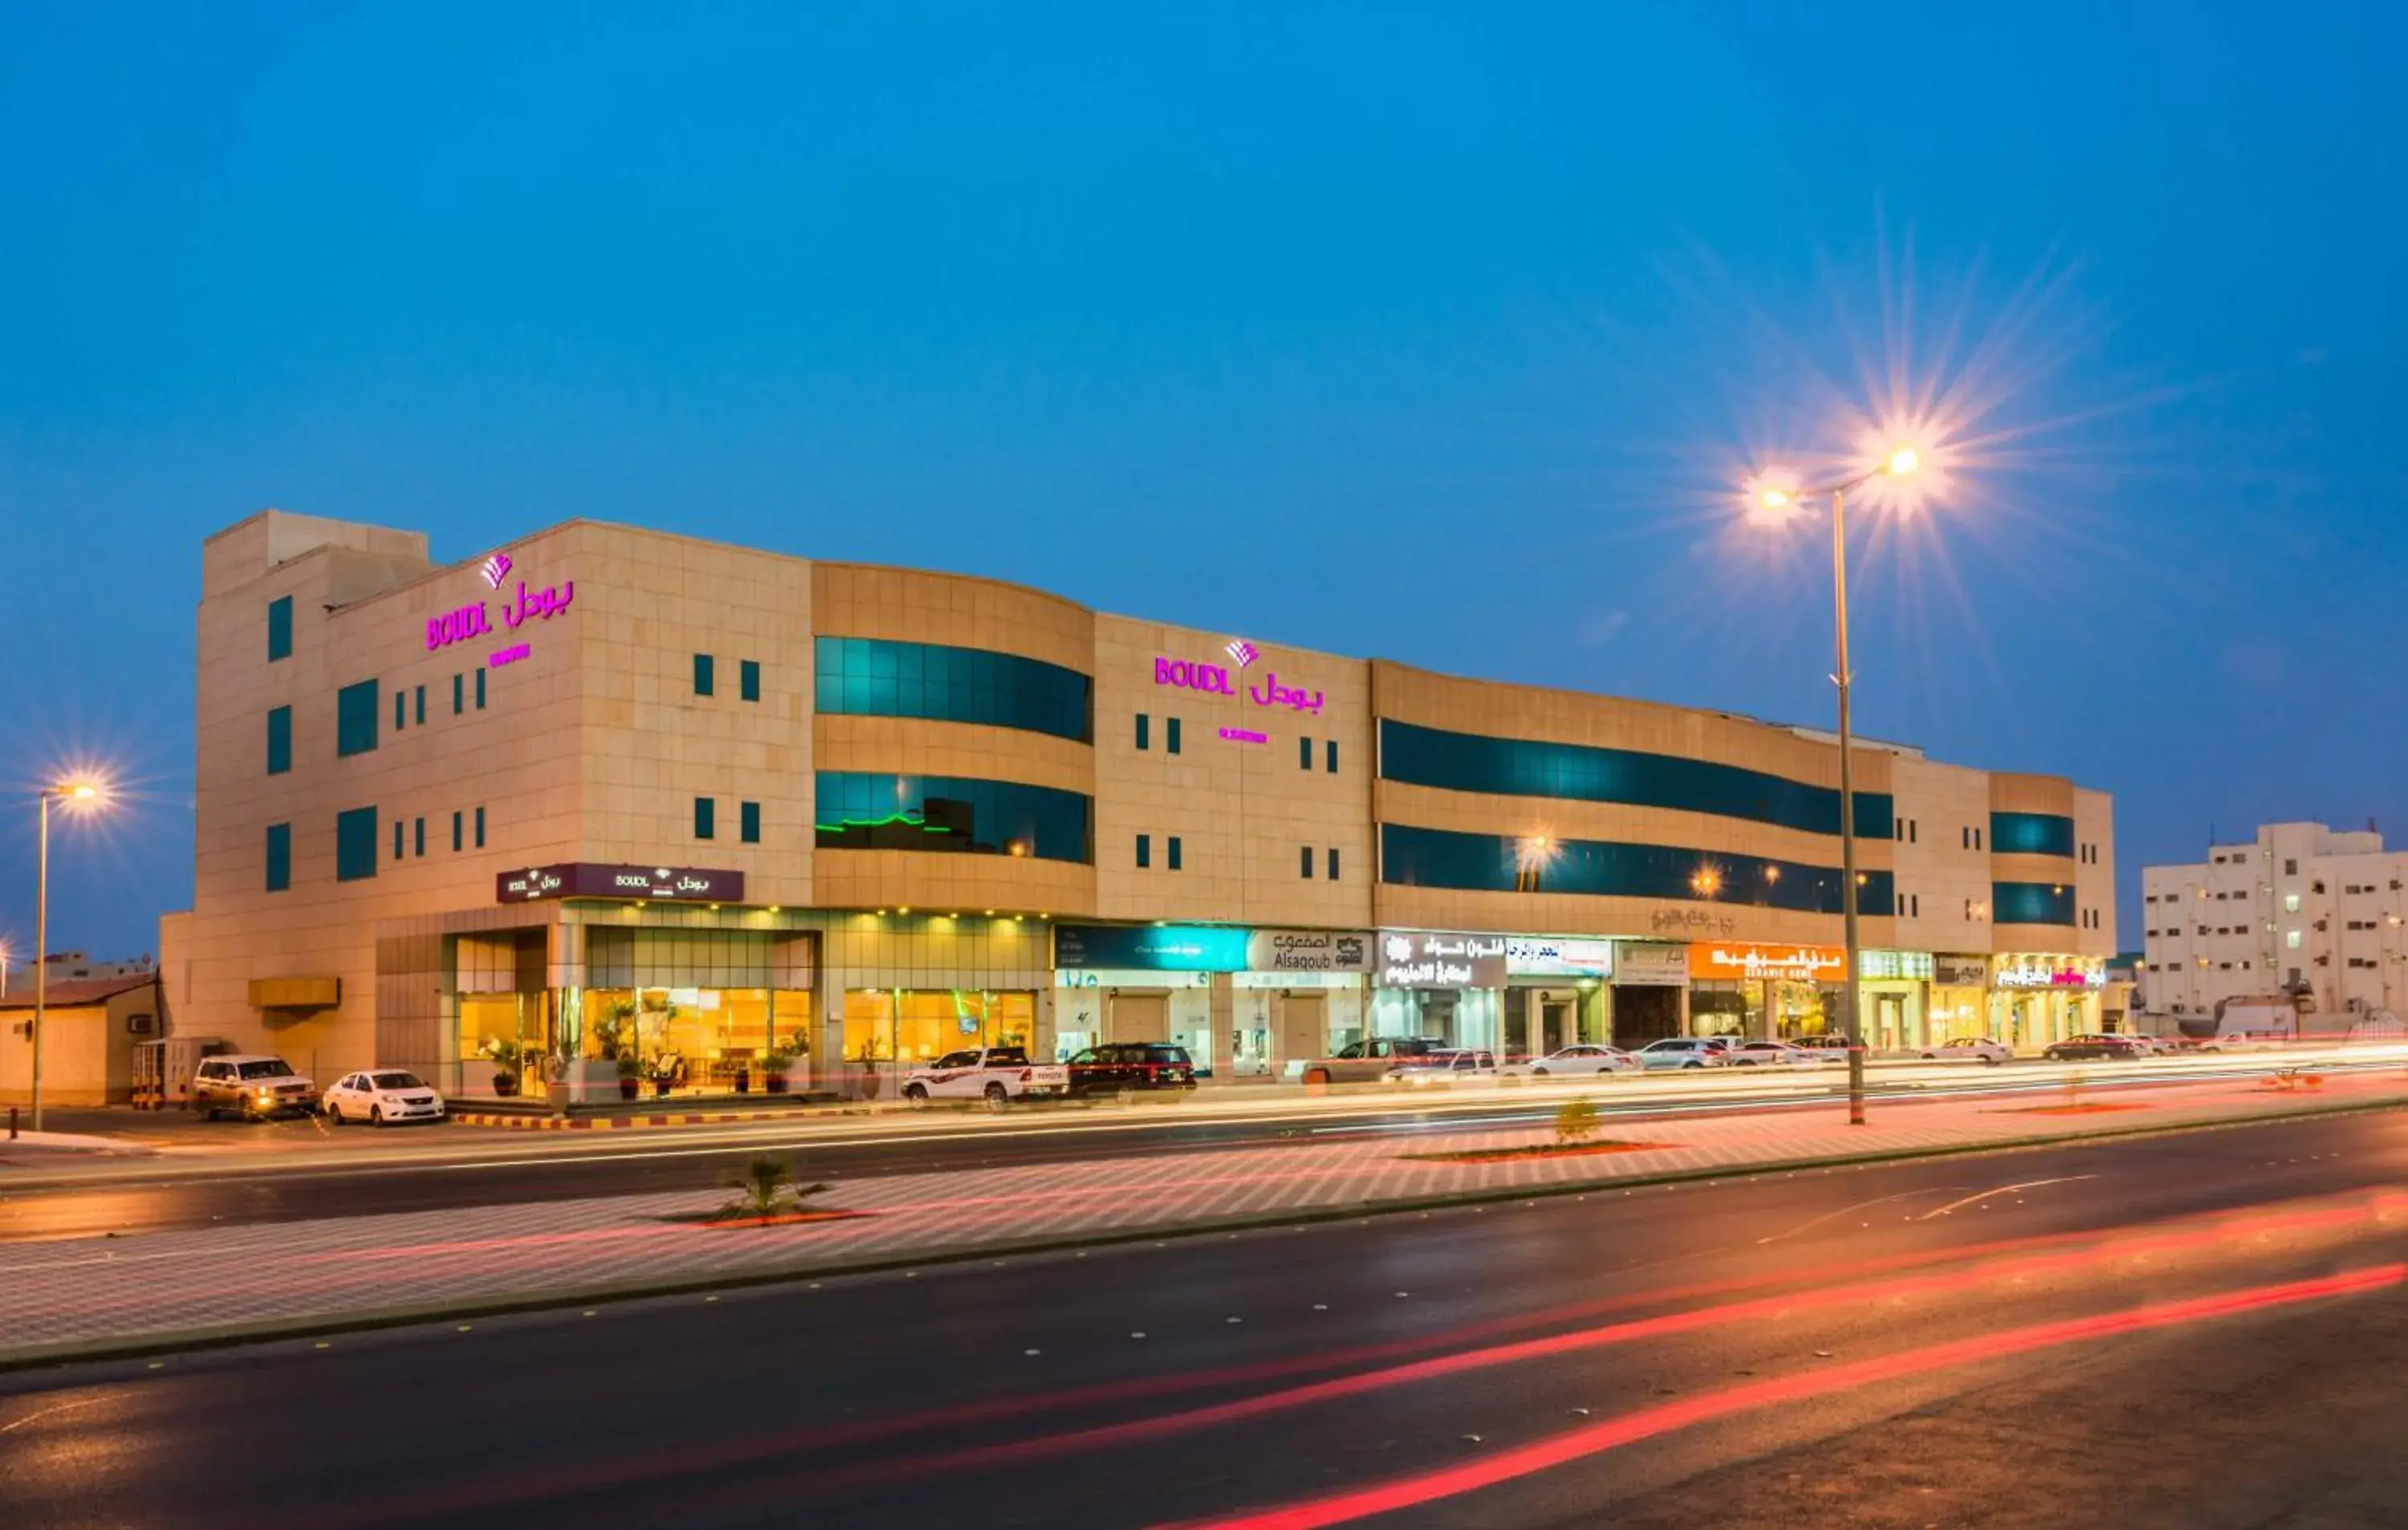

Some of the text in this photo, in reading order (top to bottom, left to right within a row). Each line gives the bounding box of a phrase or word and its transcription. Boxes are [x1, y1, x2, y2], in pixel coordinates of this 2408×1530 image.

[502, 580, 574, 629] بودل
[426, 600, 493, 651] BOUDL
[1155, 657, 1236, 695] BOUDL
[1249, 672, 1324, 715] بودل
[616, 876, 649, 887] BOUDL
[1274, 952, 1331, 970] Alsaqoub
